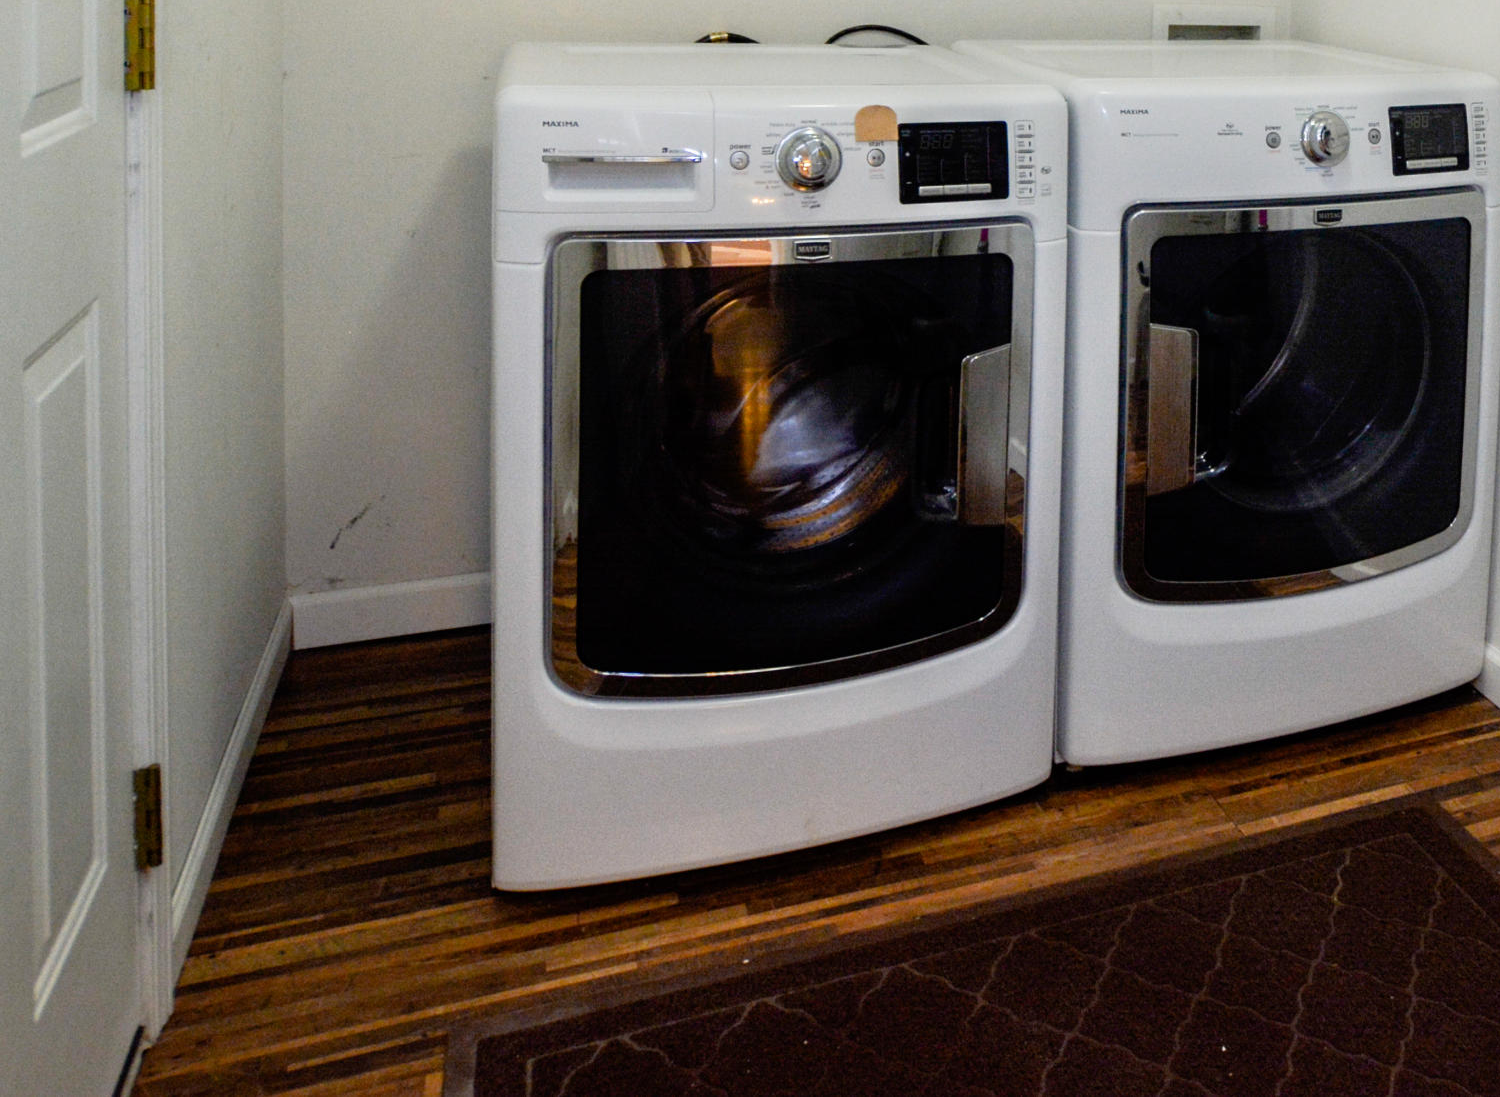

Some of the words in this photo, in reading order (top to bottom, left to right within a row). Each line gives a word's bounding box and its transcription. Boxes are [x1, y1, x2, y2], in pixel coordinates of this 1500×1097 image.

[542, 120, 580, 128] MAXIMA
[729, 143, 751, 151] power
[798, 244, 829, 253] MAYTAG
